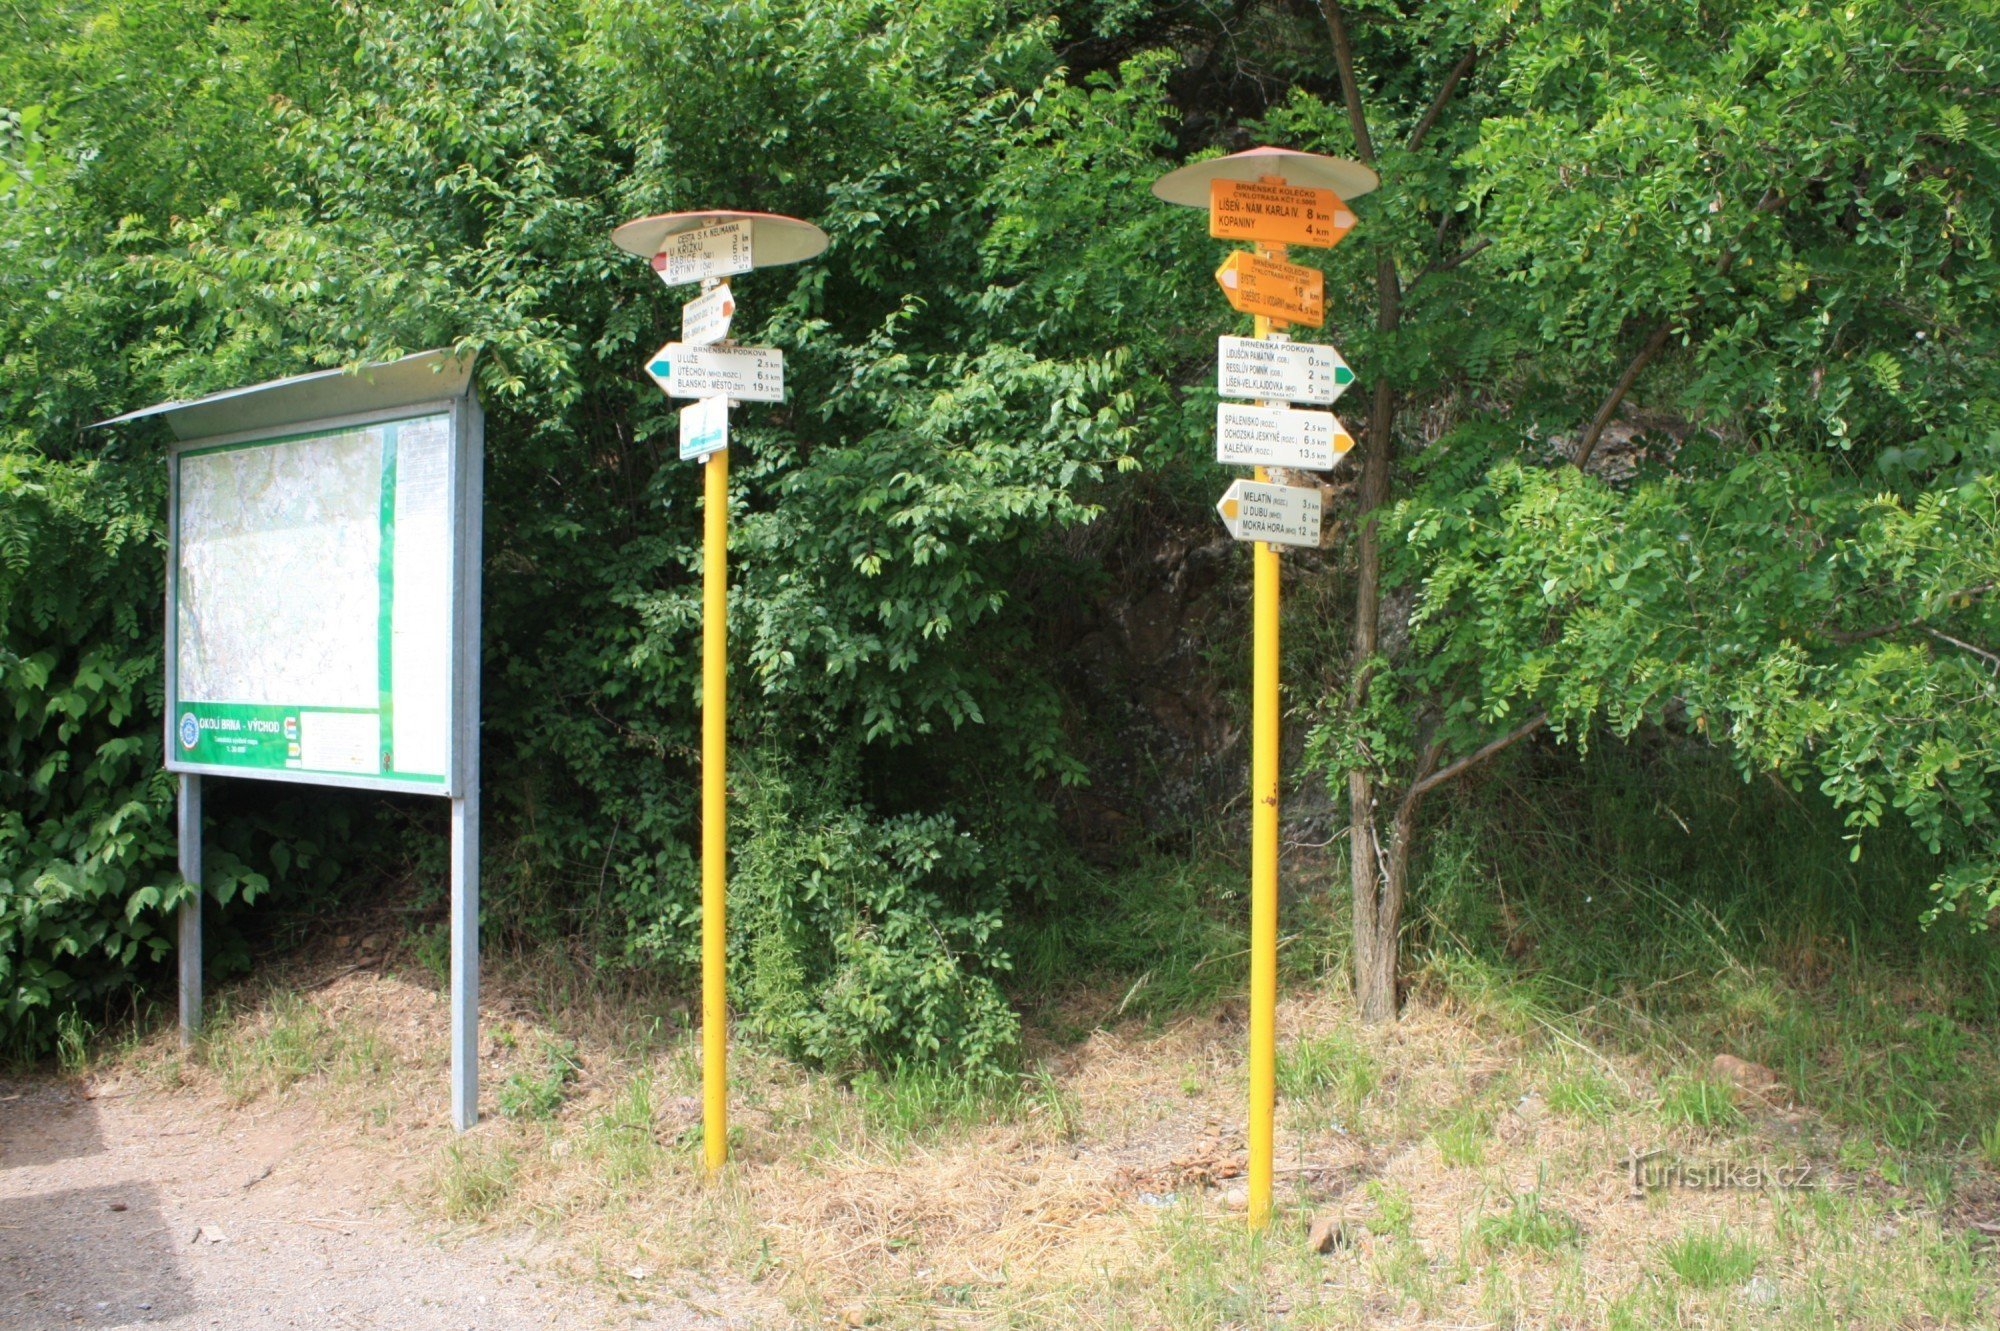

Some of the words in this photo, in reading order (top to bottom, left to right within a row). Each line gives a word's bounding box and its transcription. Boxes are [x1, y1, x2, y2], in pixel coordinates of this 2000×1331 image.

[1233, 192, 1279, 202] CYKLOTRASA
[1265, 204, 1289, 217] KARLA
[1306, 208, 1314, 220] 8
[1316, 212, 1330, 221] km
[1218, 215, 1256, 228] KOPANINY
[1305, 224, 1313, 235] 4
[1316, 228, 1330, 236] km
[670, 248, 674, 256] U
[733, 234, 737, 244] 3
[742, 233, 749, 241] km
[670, 252, 697, 266] BABICE
[1294, 286, 1304, 298] 18
[1310, 291, 1319, 301] km
[1310, 308, 1320, 316] km
[1281, 344, 1315, 353] PODKOVA
[677, 354, 682, 363] U
[770, 373, 780, 381] km
[1308, 370, 1314, 380] 2
[677, 379, 707, 389] BLANSKO
[1308, 384, 1314, 394] 5
[1317, 452, 1327, 460] km
[1244, 490, 1272, 504] MELATÍN
[1243, 506, 1248, 516] U
[1249, 507, 1268, 518] DUBU
[1302, 513, 1307, 523] 6
[1266, 524, 1285, 534] HORA
[1298, 526, 1306, 536] 12
[200, 716, 220, 730] OKOLÍ
[221, 718, 241, 731] BRNA
[247, 718, 280, 733] VÝCHOD
